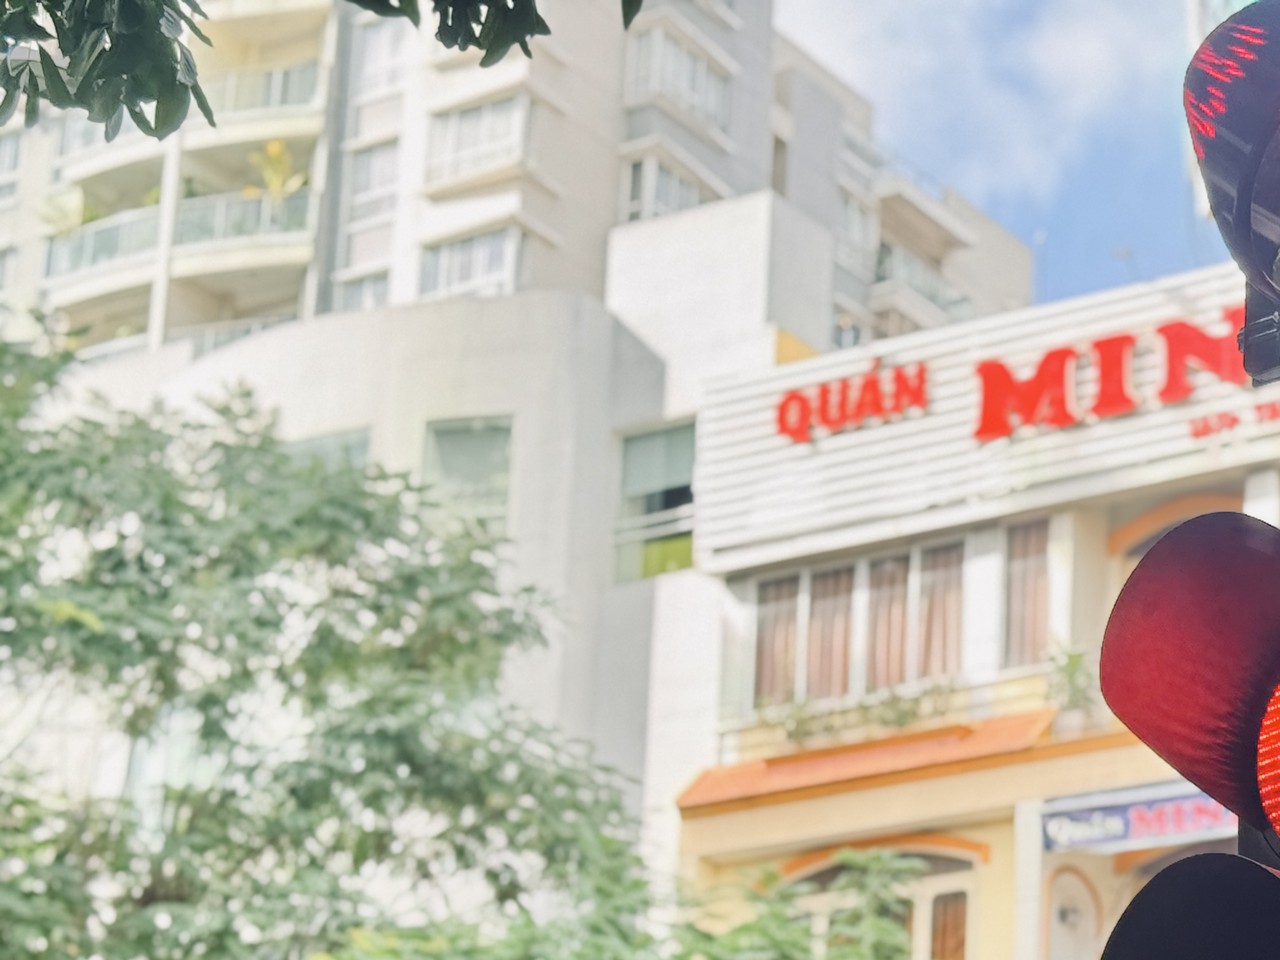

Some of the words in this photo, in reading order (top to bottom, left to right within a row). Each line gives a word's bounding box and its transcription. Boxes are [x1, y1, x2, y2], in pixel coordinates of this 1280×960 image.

[777, 357, 928, 444] QUÁN
[974, 305, 1246, 443] MIN
[1128, 797, 1238, 840] MIN
